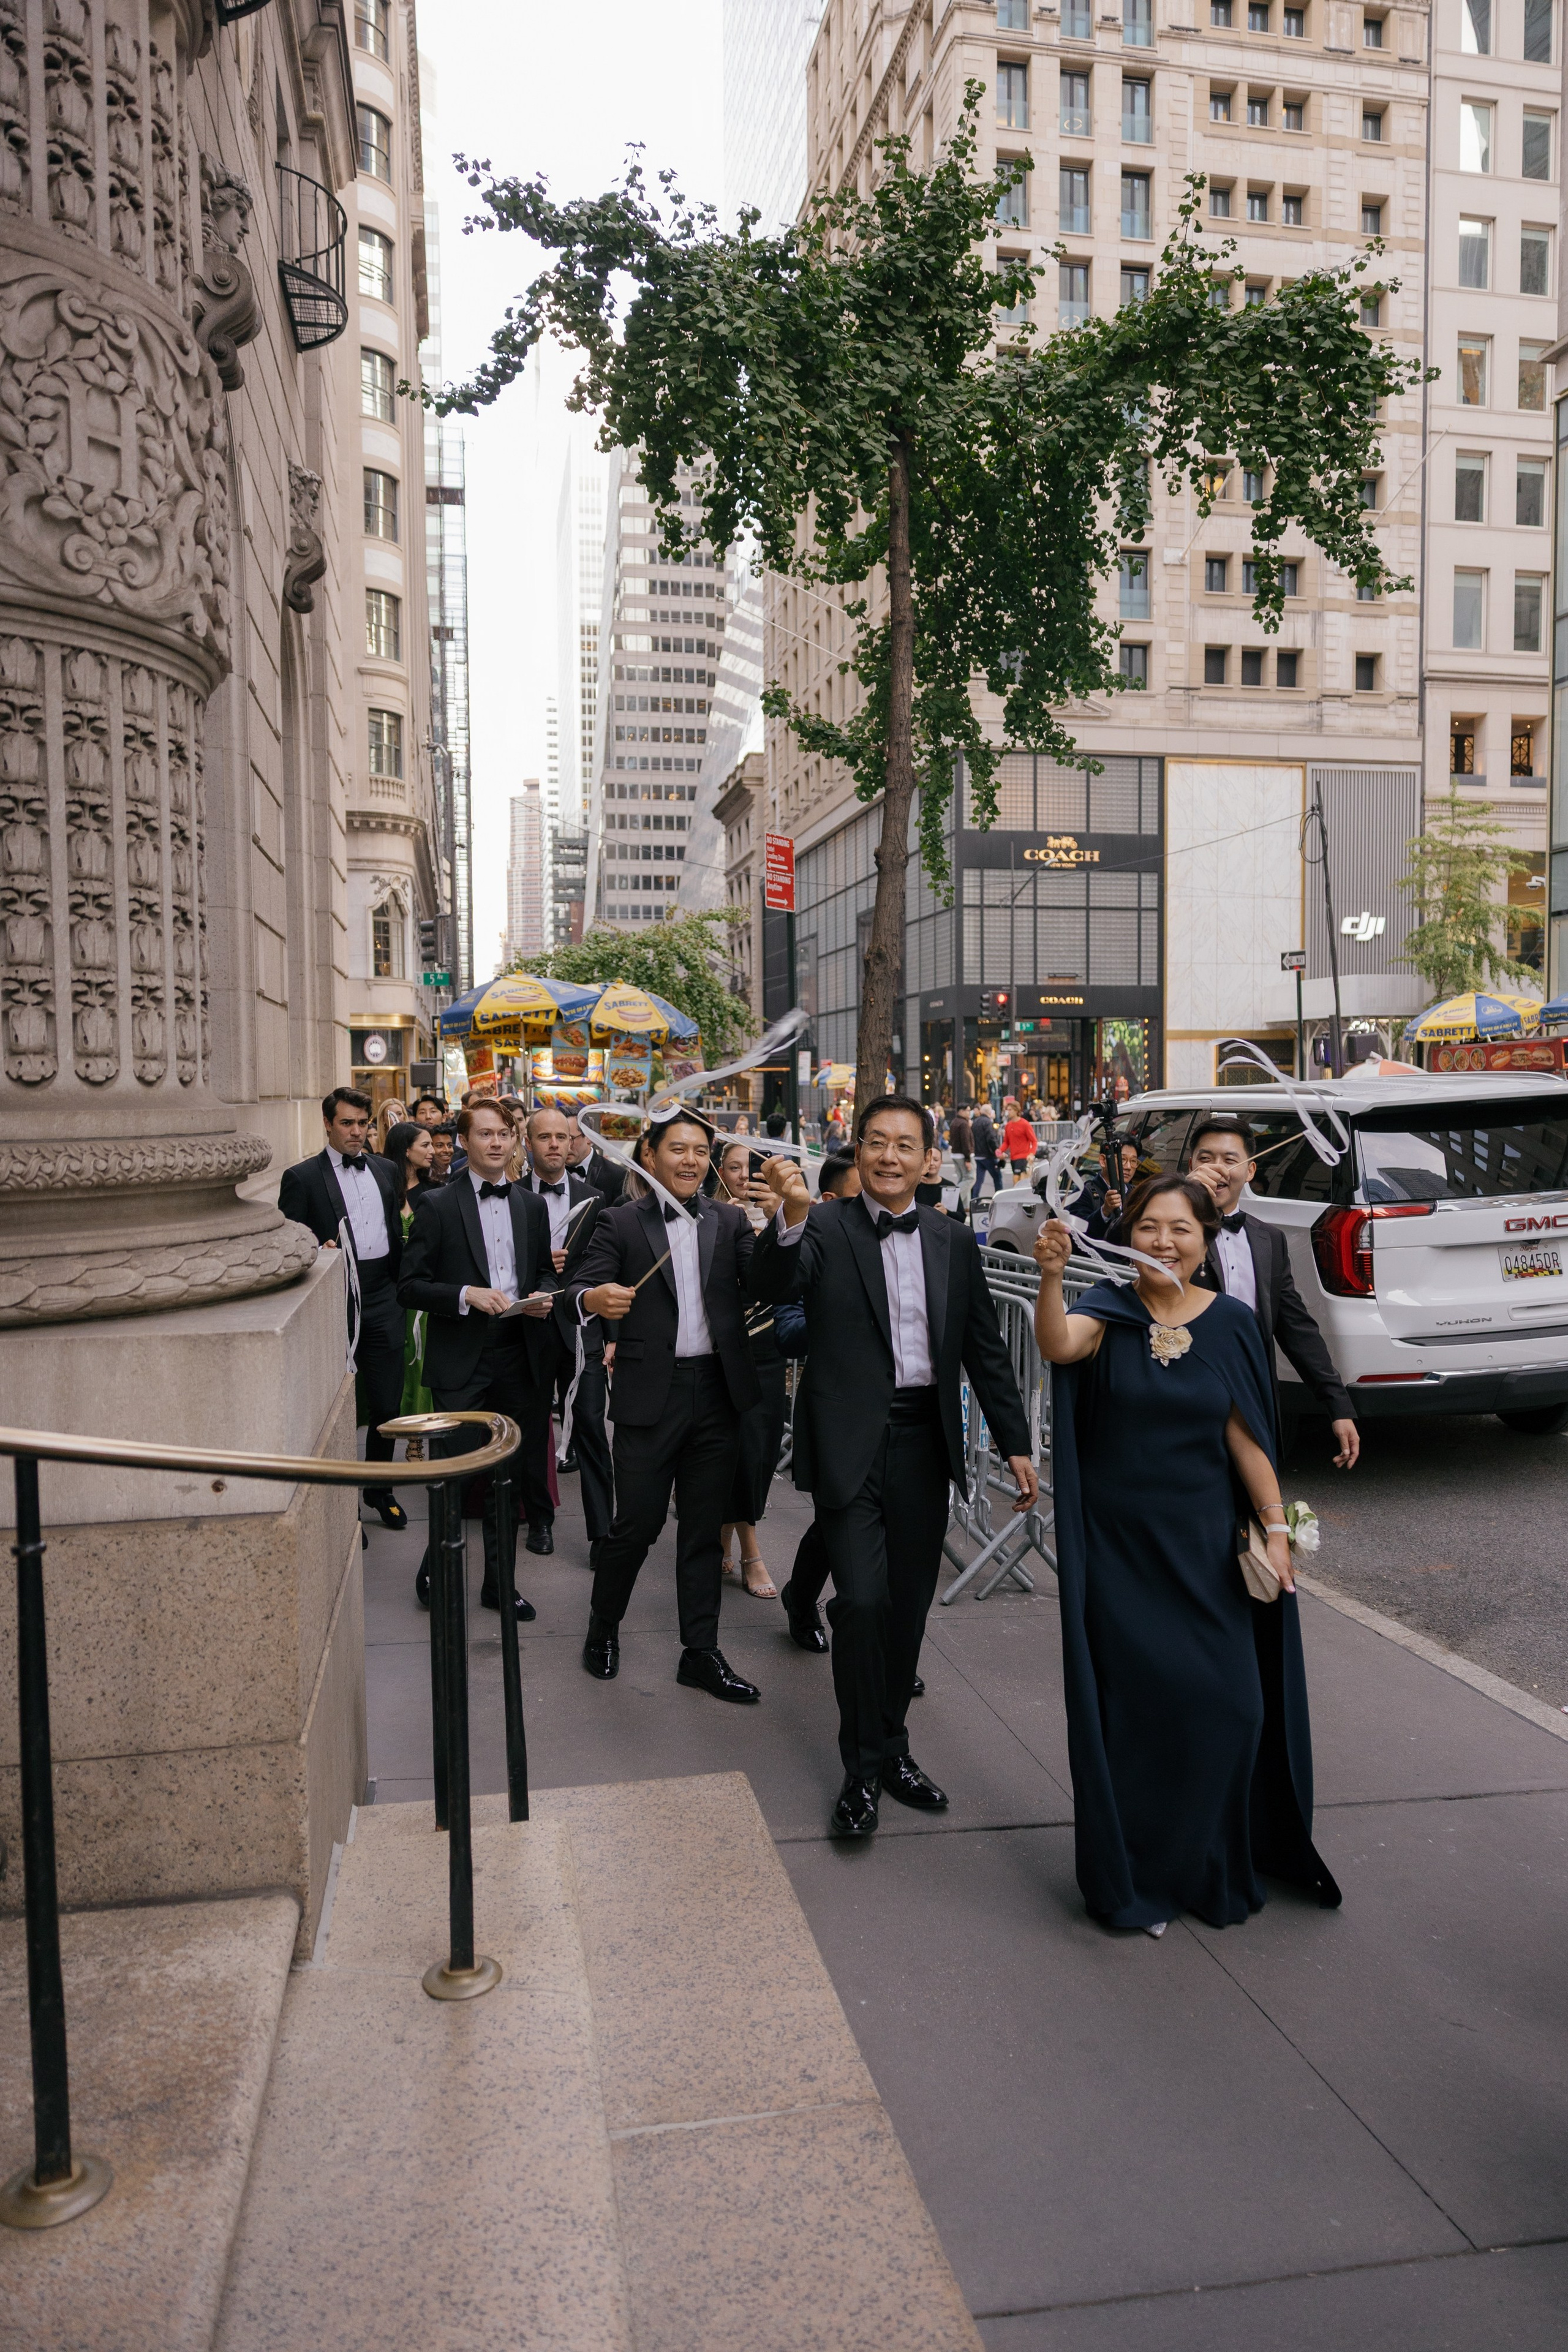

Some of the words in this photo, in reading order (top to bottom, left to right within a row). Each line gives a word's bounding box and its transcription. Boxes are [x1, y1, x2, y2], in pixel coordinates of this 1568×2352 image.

[772, 837, 790, 848] STANDING
[1023, 849, 1100, 862] COACH
[767, 872, 772, 881] NO
[772, 874, 791, 884] STANDING
[767, 881, 783, 892] Anytime
[429, 973, 435, 984] 5
[604, 1000, 649, 1010] SABRETT
[1420, 1027, 1472, 1037] SABRETT
[1504, 1214, 1568, 1233] GMC
[1436, 1317, 1492, 1325] YUKON
